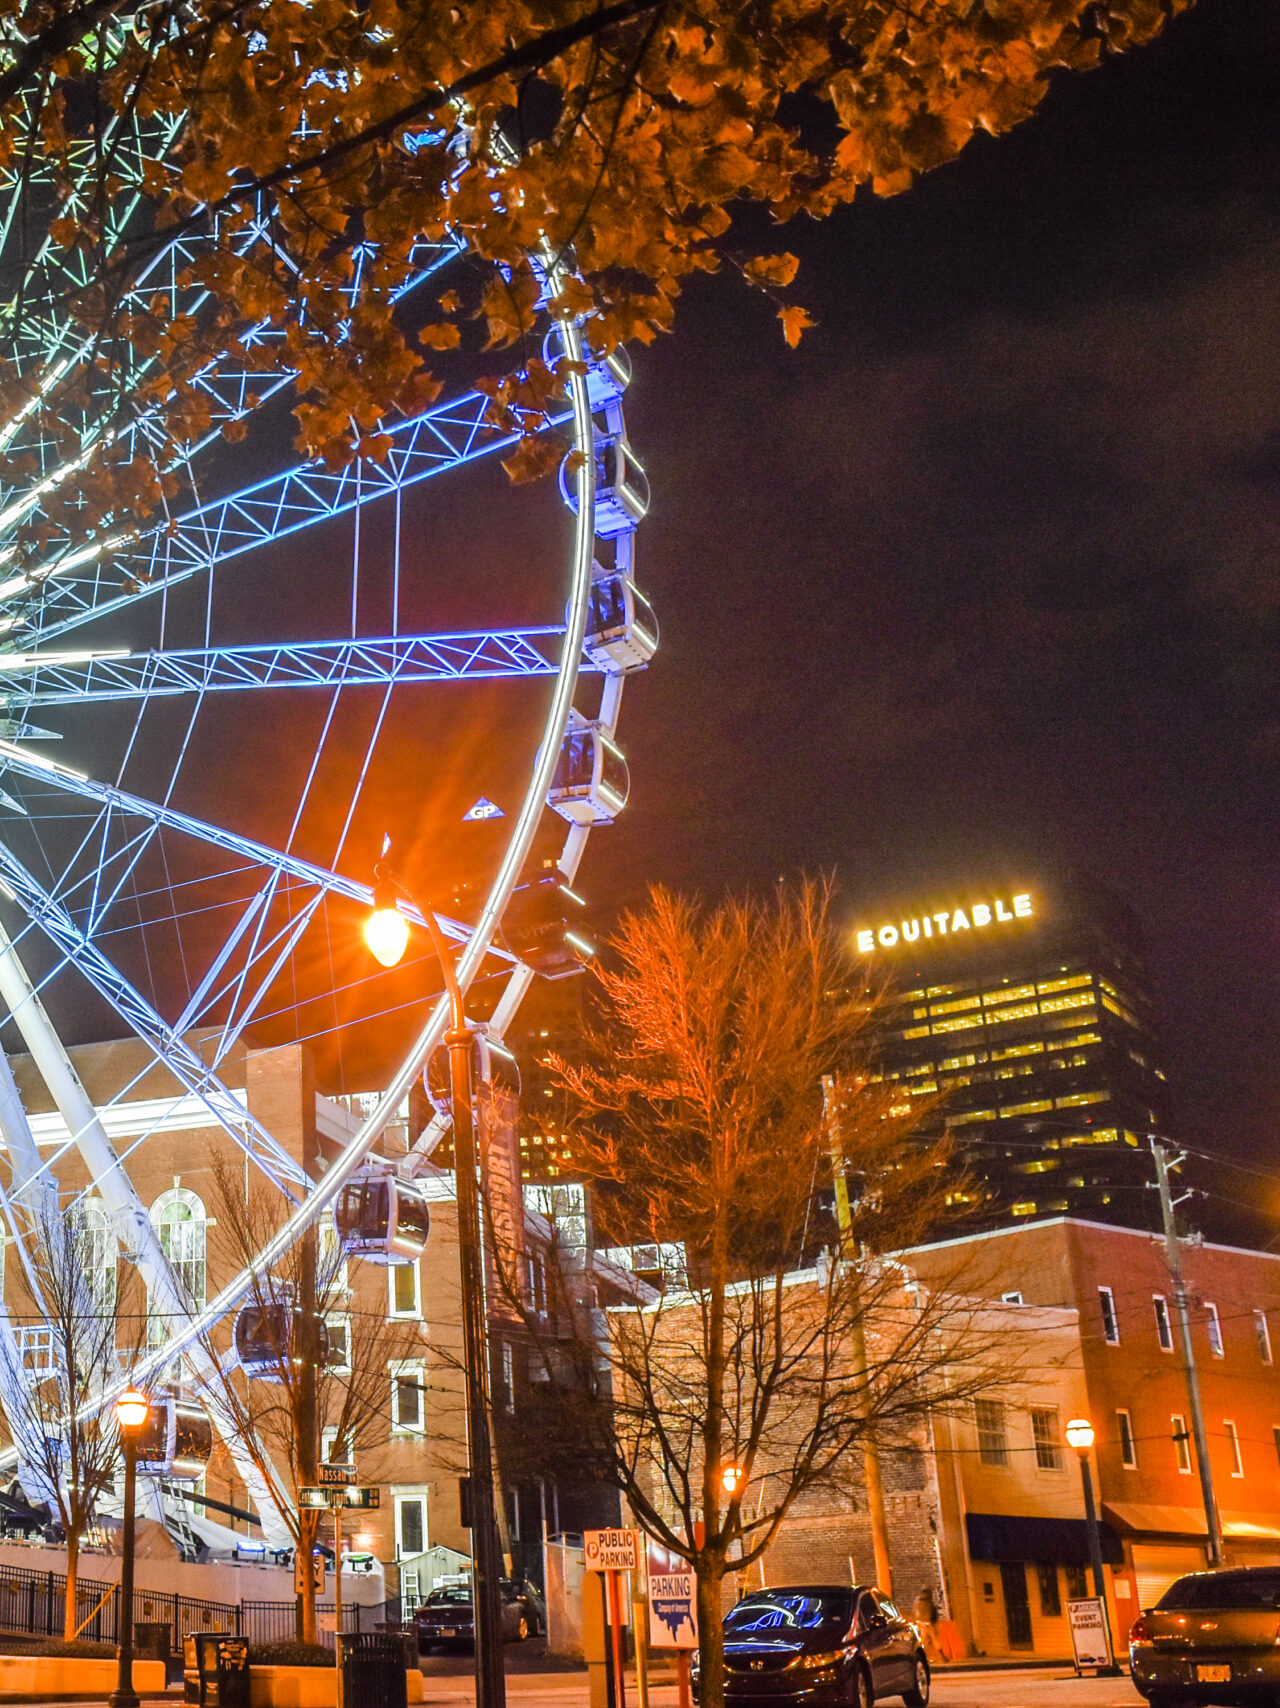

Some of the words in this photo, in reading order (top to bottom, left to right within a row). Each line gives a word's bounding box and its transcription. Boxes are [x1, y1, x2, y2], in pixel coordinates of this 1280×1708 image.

[470, 805, 496, 819] GP
[856, 893, 1033, 953] EQUITABLE
[320, 1466, 347, 1482] Nassau
[599, 1532, 633, 1548] PUBLIC
[600, 1551, 634, 1568] PARKING
[651, 1576, 691, 1597] PARKING
[1072, 1621, 1102, 1630] PARKING
[1074, 1614, 1097, 1622] EVENT
